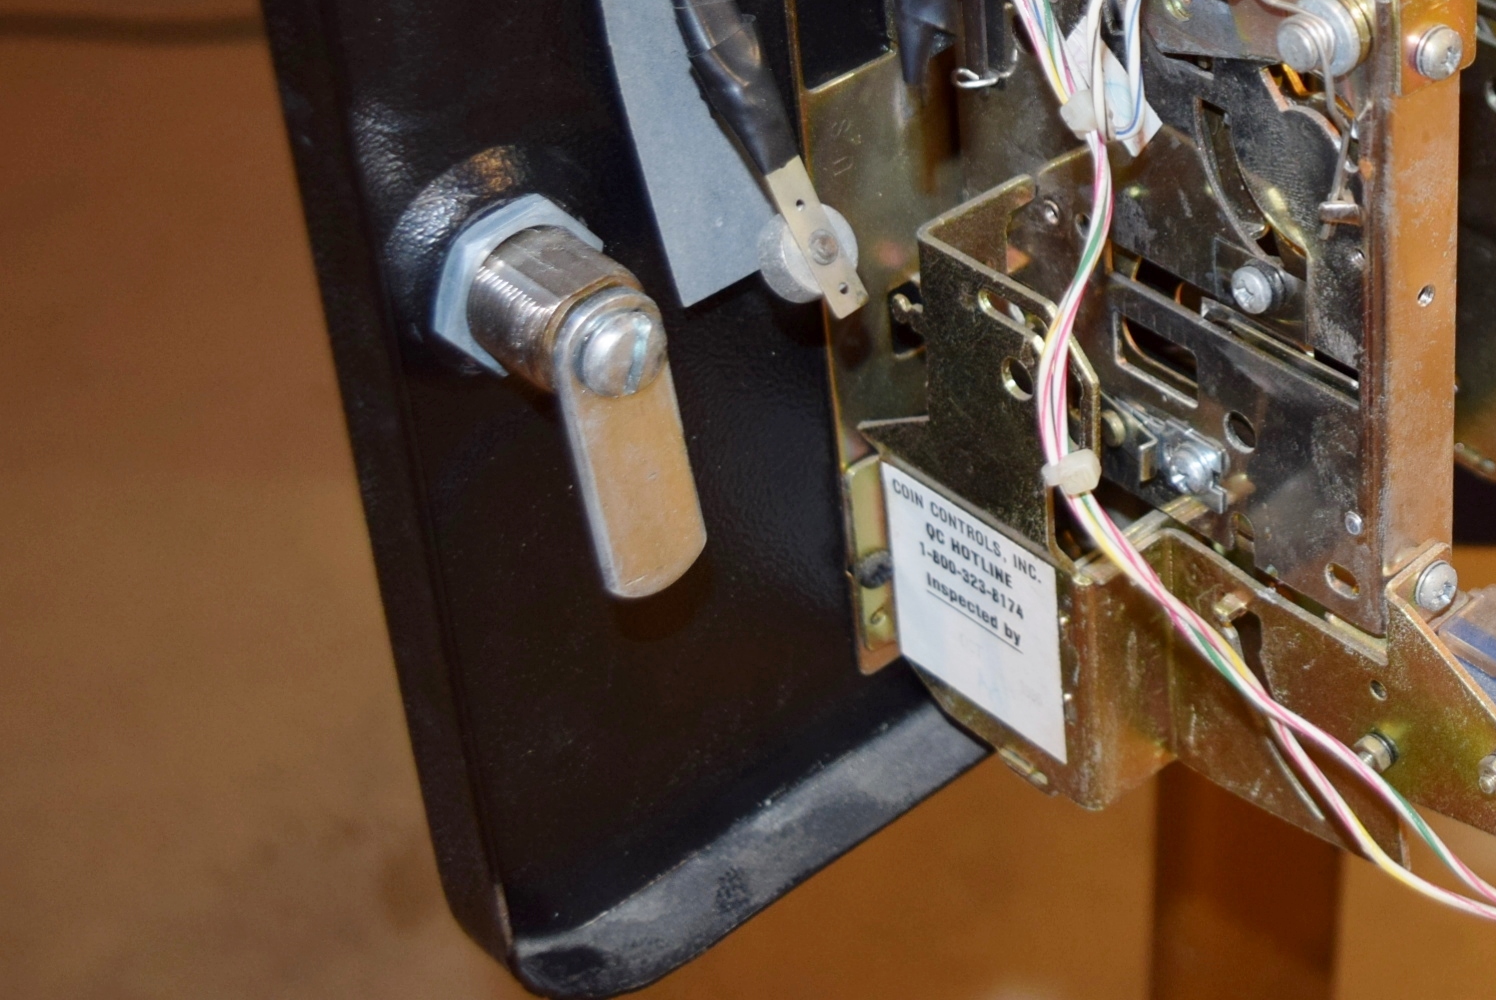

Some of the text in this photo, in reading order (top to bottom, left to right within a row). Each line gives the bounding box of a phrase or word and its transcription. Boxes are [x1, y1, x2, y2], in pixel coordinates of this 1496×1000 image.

[892, 478, 1042, 583] COIN CONTROLS, INC.
[925, 522, 1013, 589] QC HOTLINE
[926, 572, 999, 629] Inspected
[1004, 622, 1021, 646] by
